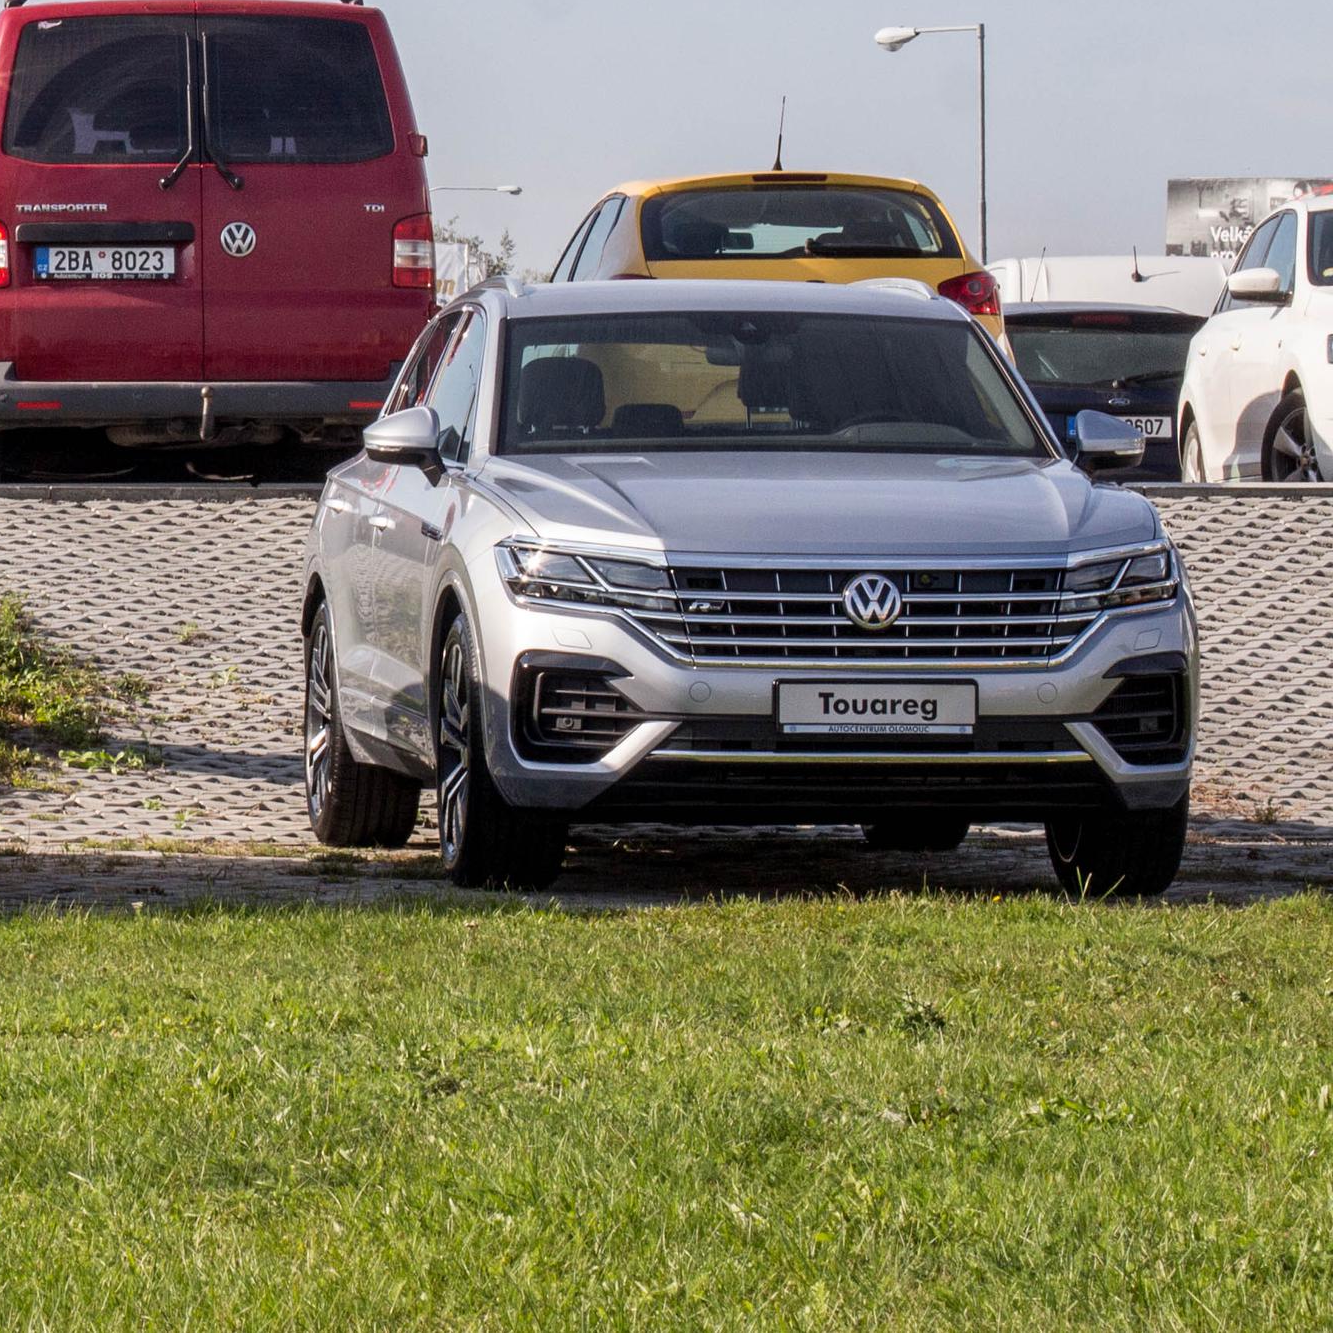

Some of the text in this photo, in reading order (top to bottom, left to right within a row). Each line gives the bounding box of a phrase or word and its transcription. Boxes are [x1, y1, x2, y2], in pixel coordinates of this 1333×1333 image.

[16, 203, 108, 212] TRANSPORTER
[363, 204, 385, 212] TDI
[54, 250, 164, 271] 2BA 8023
[844, 574, 901, 628] VW
[818, 692, 938, 721] Touareg
[888, 725, 929, 733] OLOMOUC
